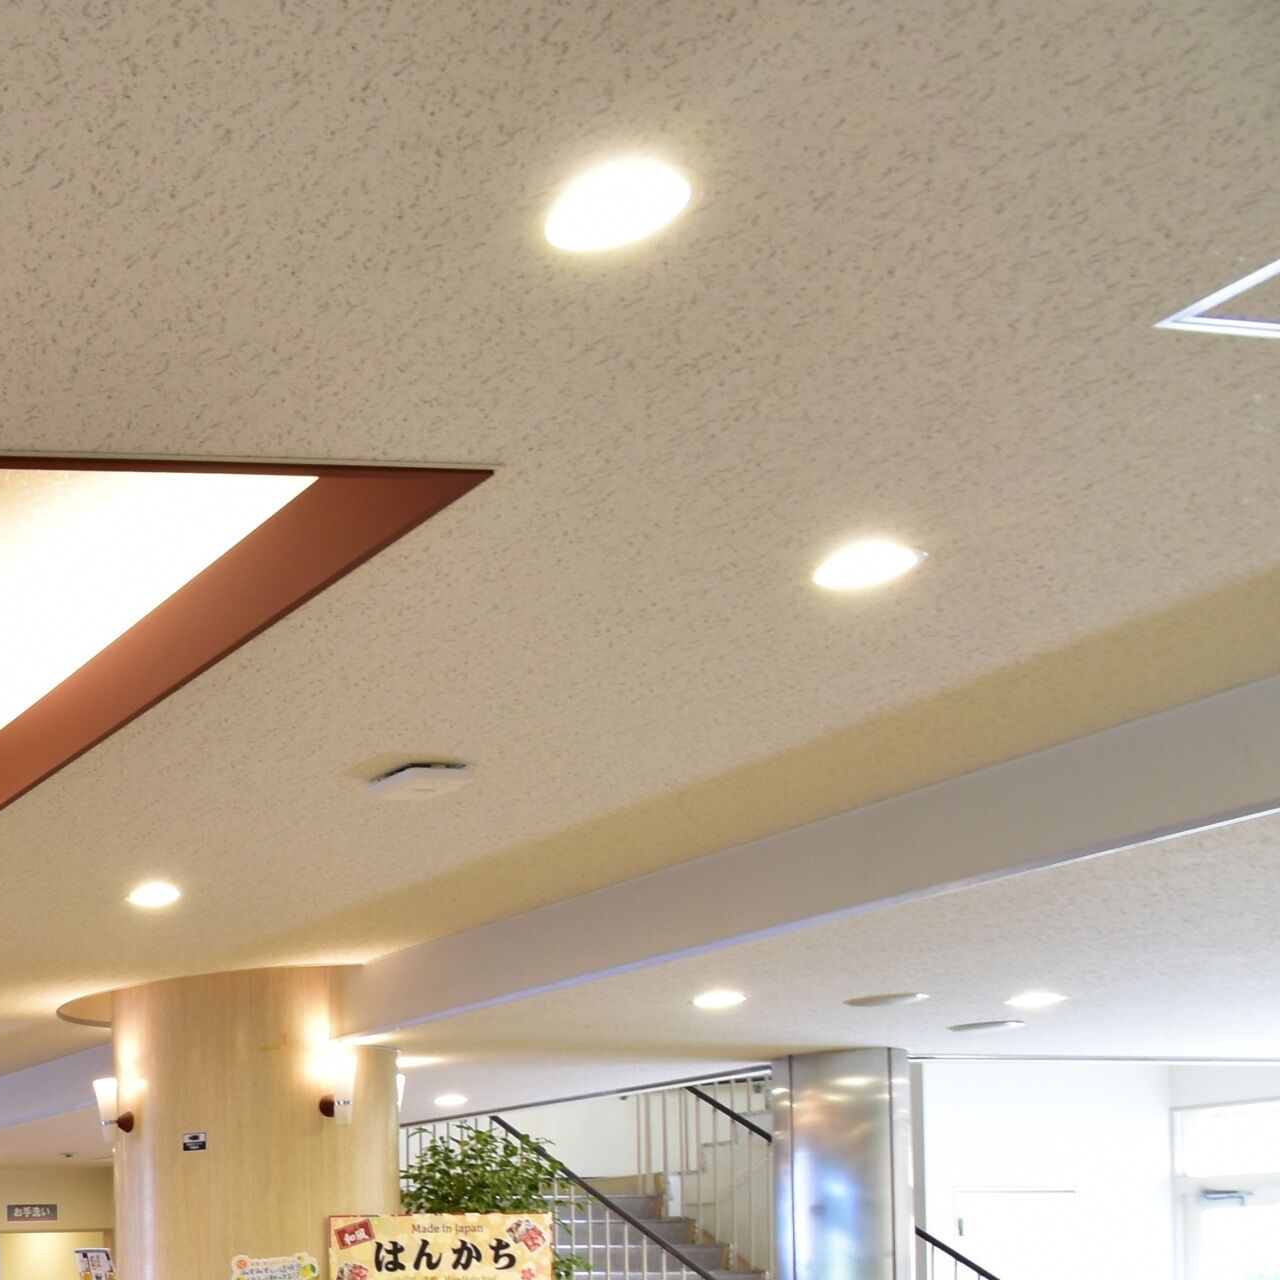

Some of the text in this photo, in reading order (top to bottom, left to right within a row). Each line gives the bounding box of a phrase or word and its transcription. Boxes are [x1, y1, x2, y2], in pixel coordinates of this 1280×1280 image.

[13, 1206, 51, 1217] お手洗い
[411, 1223, 484, 1235] Made in Japan
[374, 1238, 517, 1272] はんかち
